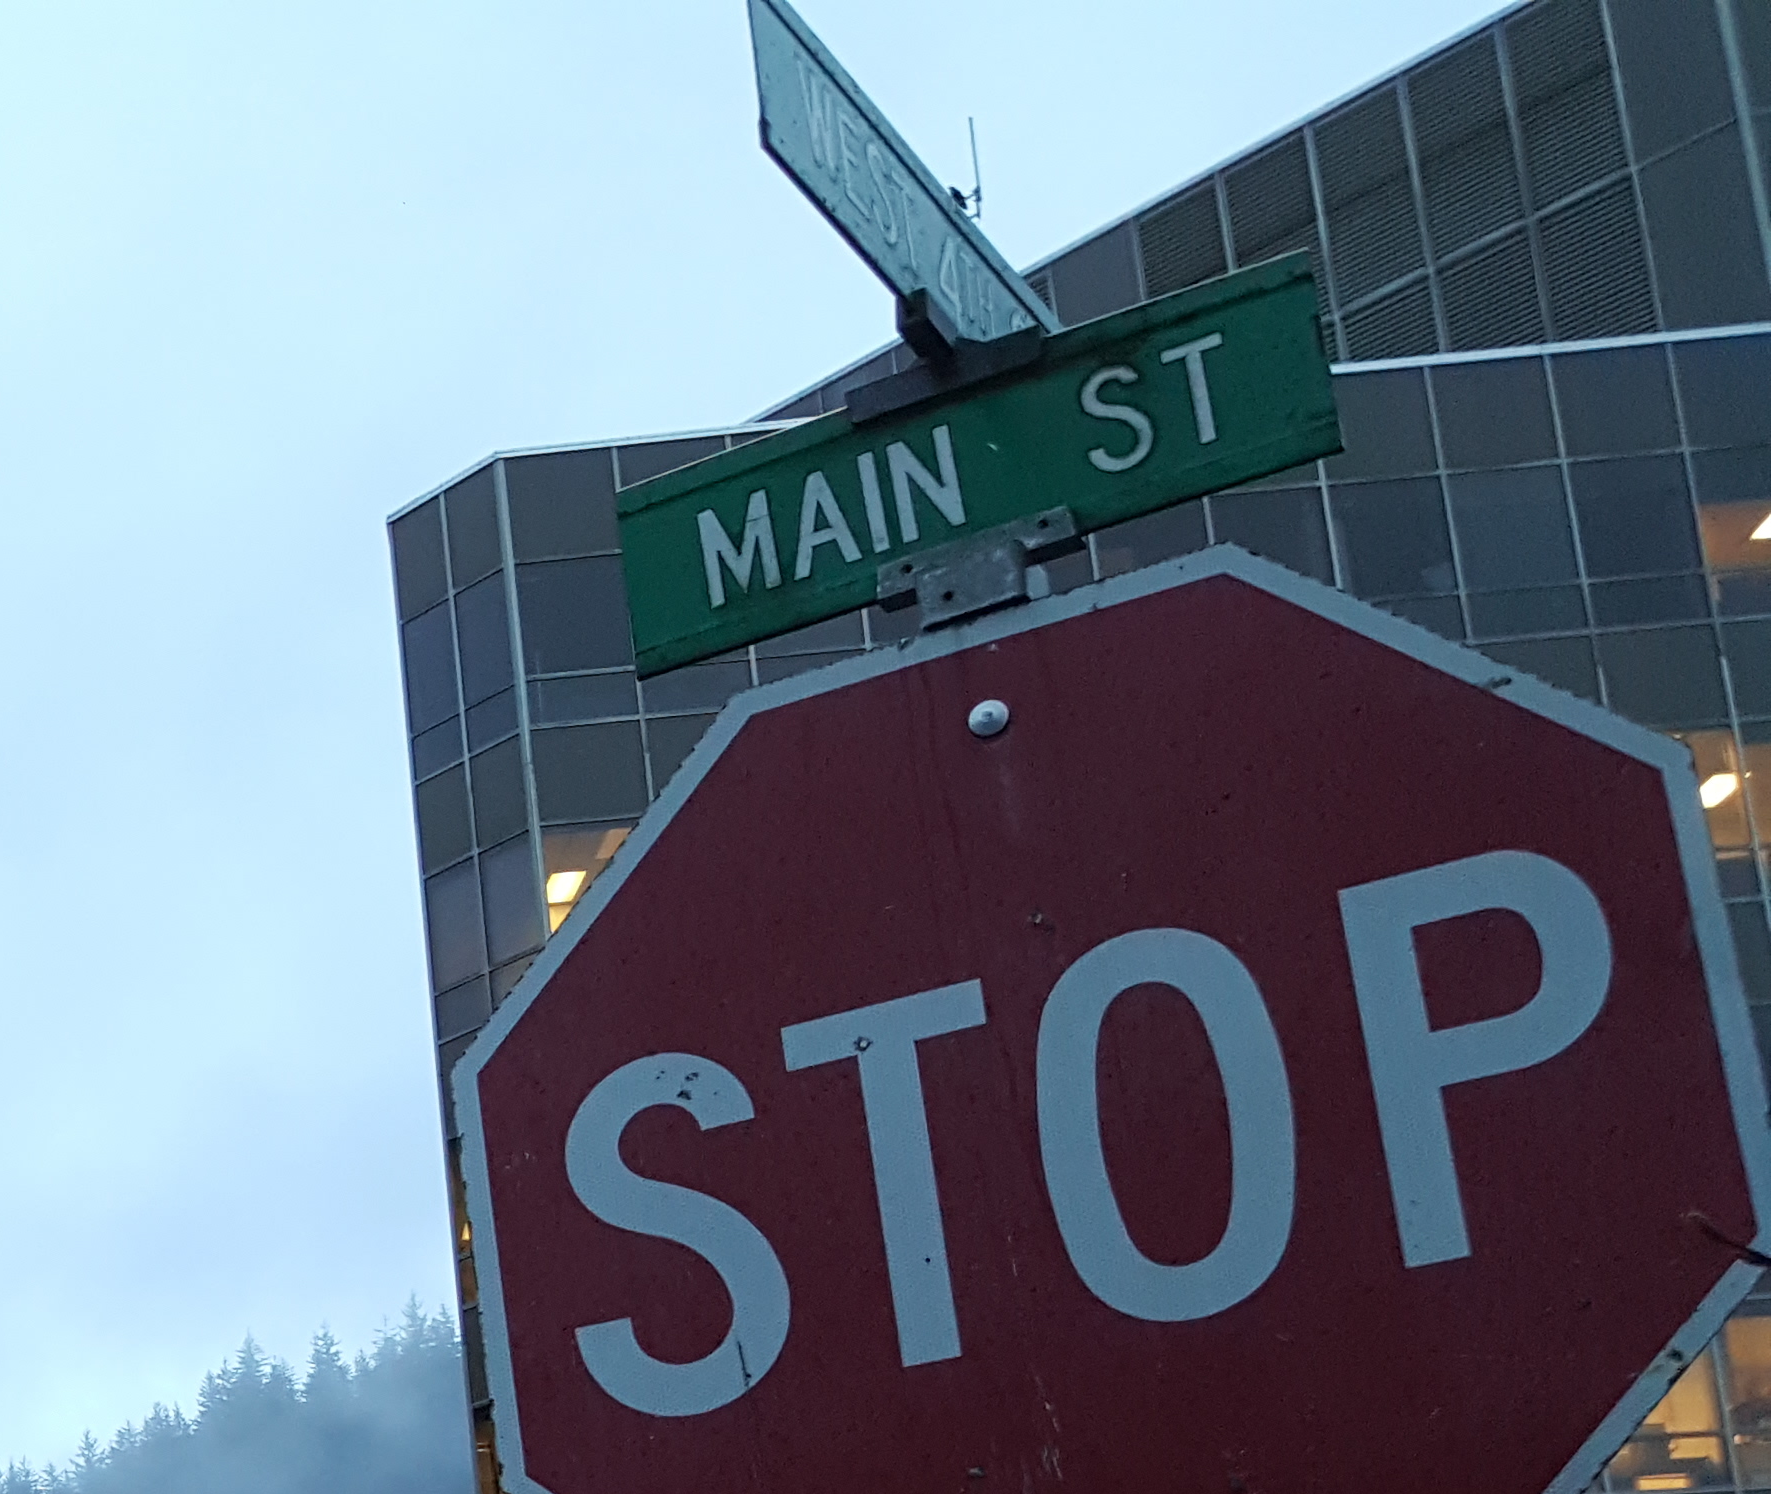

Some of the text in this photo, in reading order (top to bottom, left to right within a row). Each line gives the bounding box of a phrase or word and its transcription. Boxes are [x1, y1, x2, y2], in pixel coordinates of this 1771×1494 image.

[794, 50, 996, 335] WEST 4TH
[696, 332, 1223, 609] MAIN ST
[564, 849, 1613, 1418] STOP
